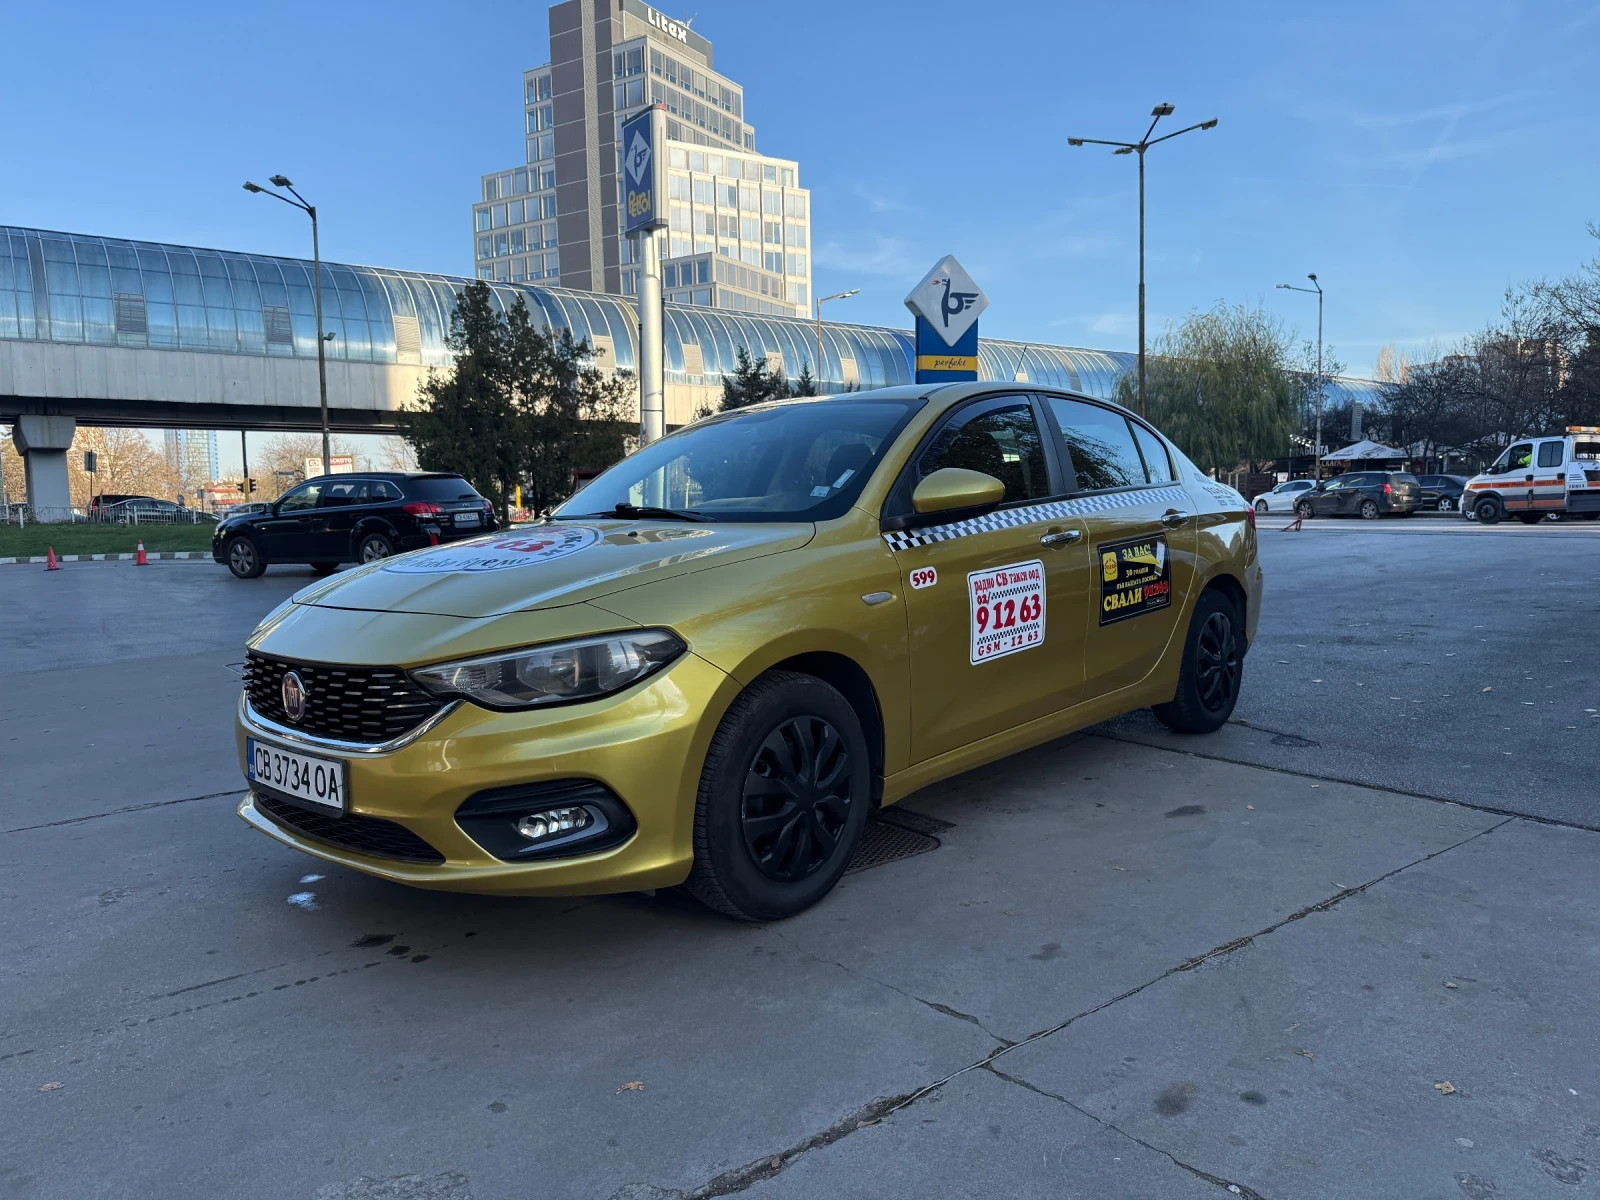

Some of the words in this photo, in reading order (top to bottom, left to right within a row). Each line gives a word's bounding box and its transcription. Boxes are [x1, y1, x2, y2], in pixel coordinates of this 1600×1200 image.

[647, 7, 687, 43] Litex
[628, 190, 651, 218] Petrol
[934, 358, 967, 369] perfekt
[1121, 549, 1134, 560] ЗА
[912, 569, 935, 587] 599
[995, 572, 1009, 588] СВ
[1008, 570, 1028, 584] такси
[1103, 587, 1143, 612] СВАЛИ
[977, 640, 1001, 656] GSM
[274, 753, 311, 794] 3734
